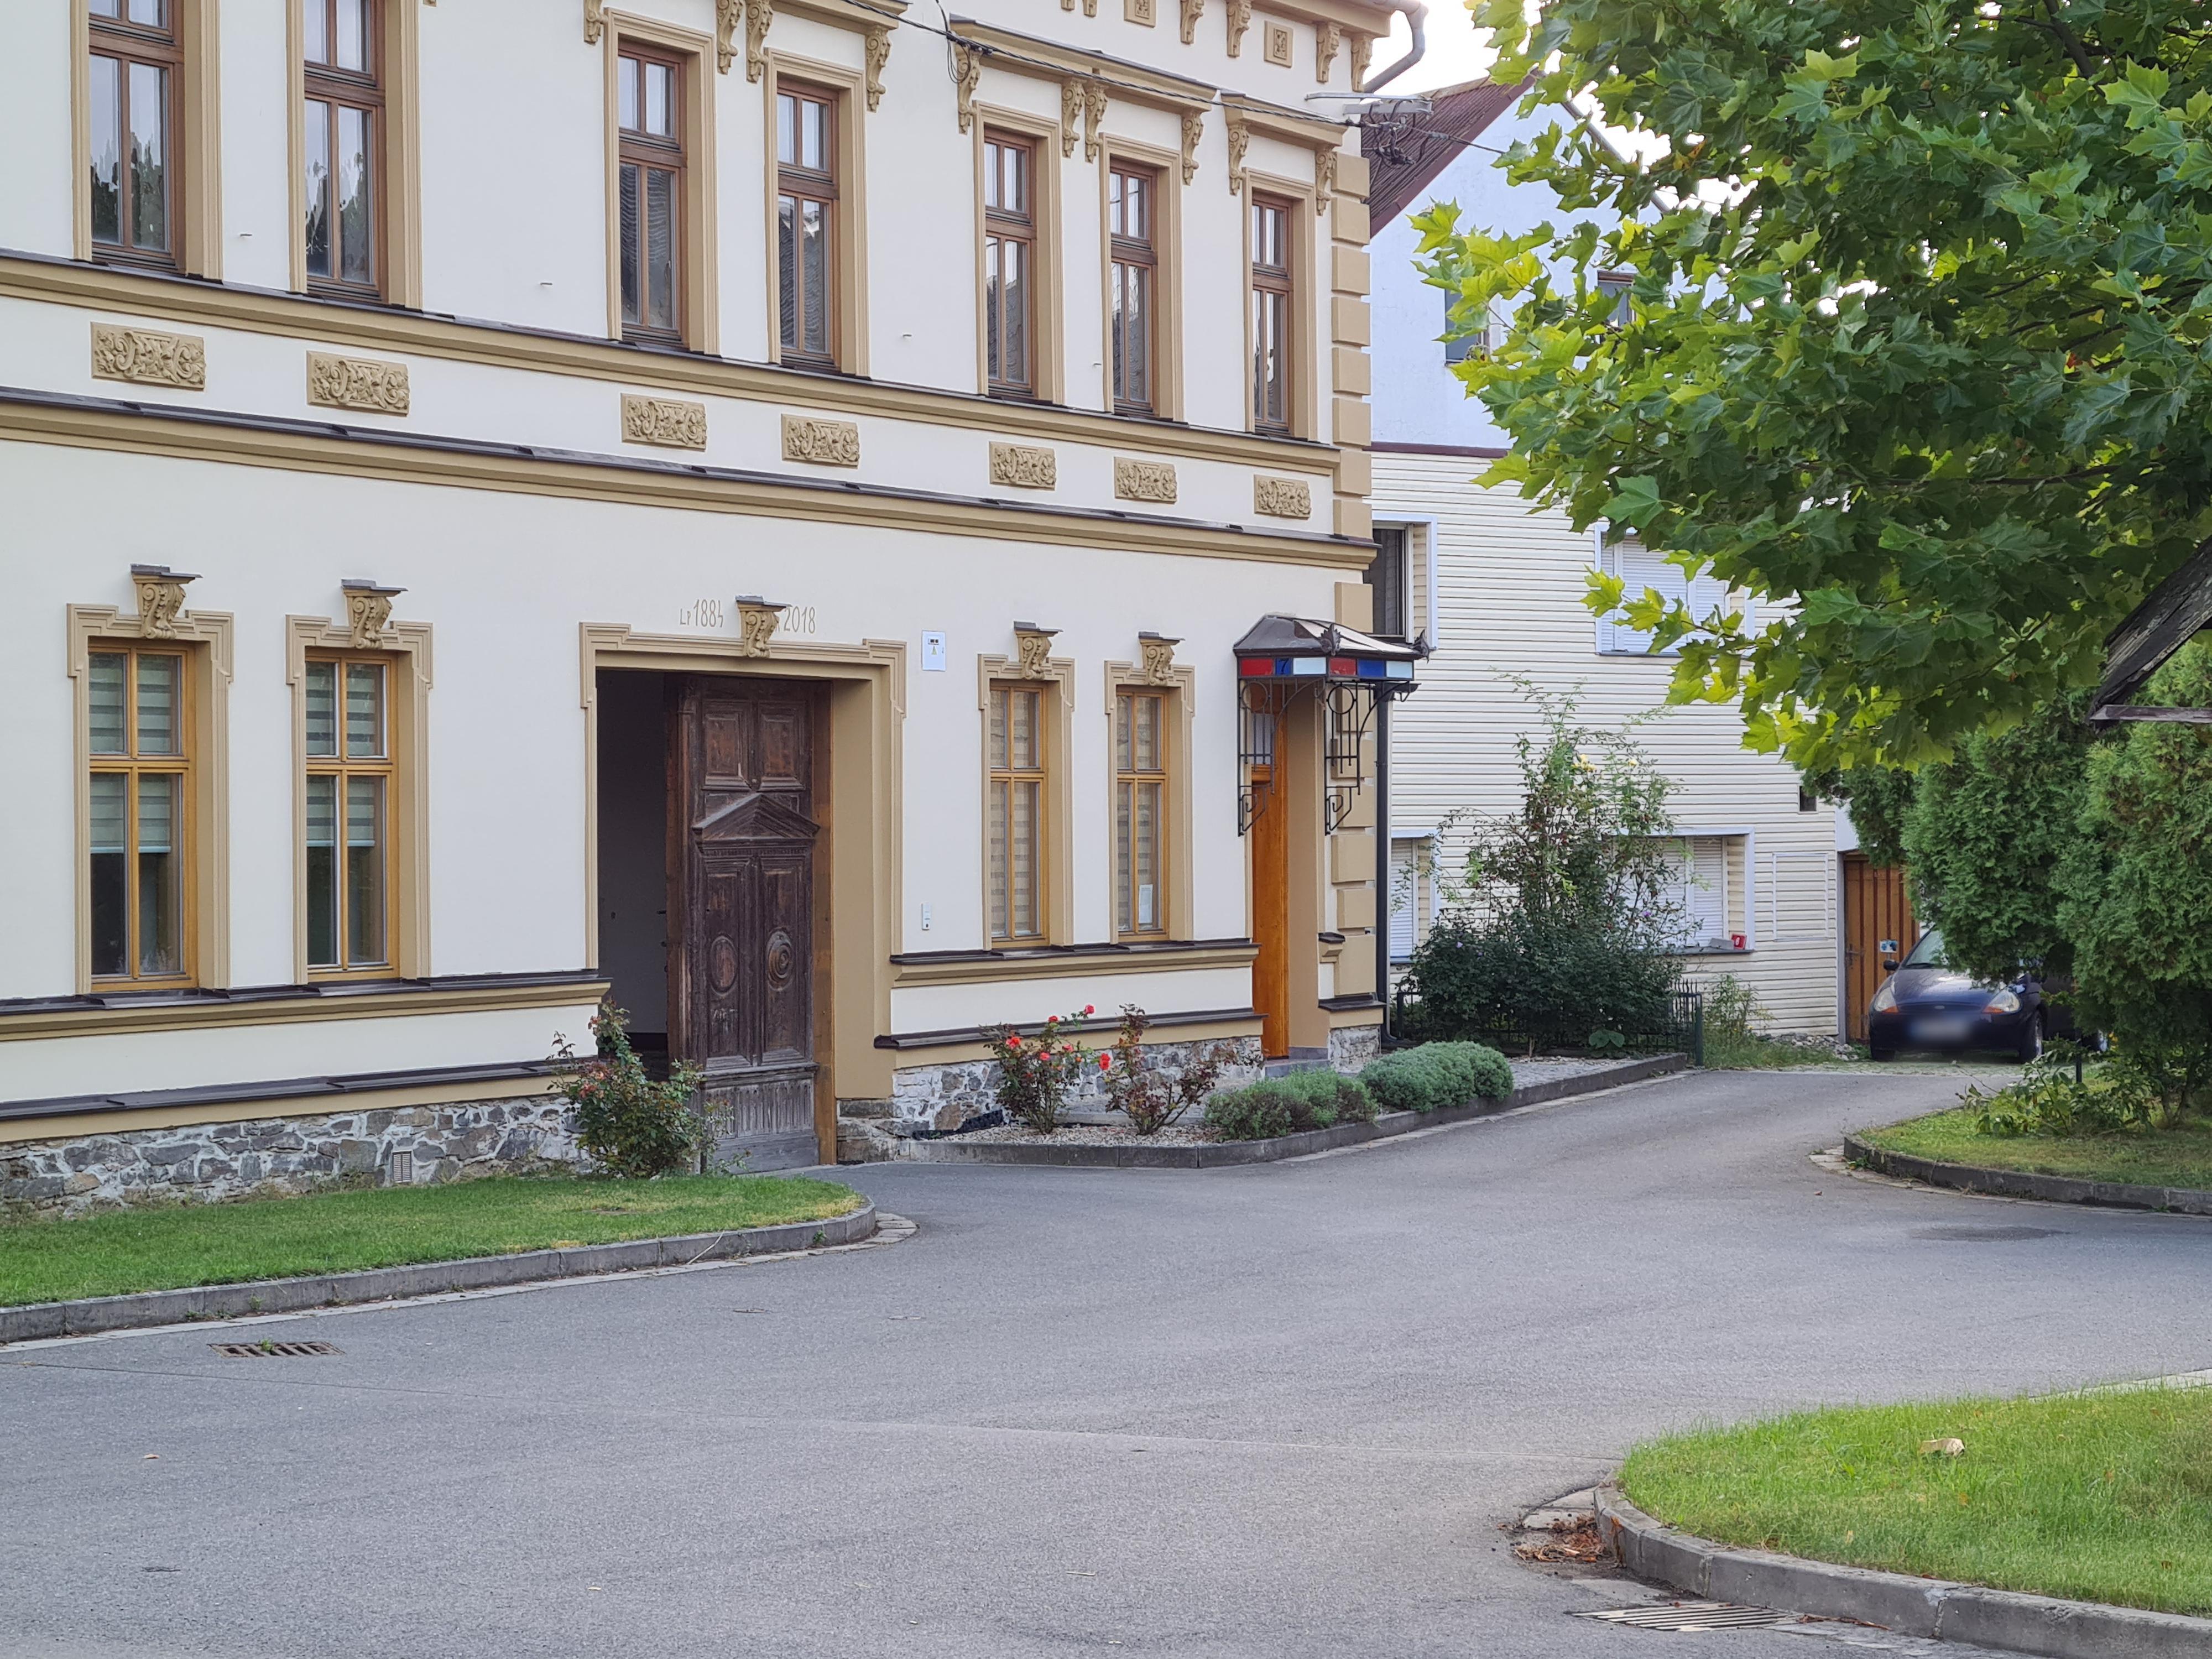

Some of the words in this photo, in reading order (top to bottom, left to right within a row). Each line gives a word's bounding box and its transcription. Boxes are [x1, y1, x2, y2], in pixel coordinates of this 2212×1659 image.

[693, 599, 723, 628] 1884
[784, 606, 815, 634] 2018
[1279, 658, 1289, 674] 7
